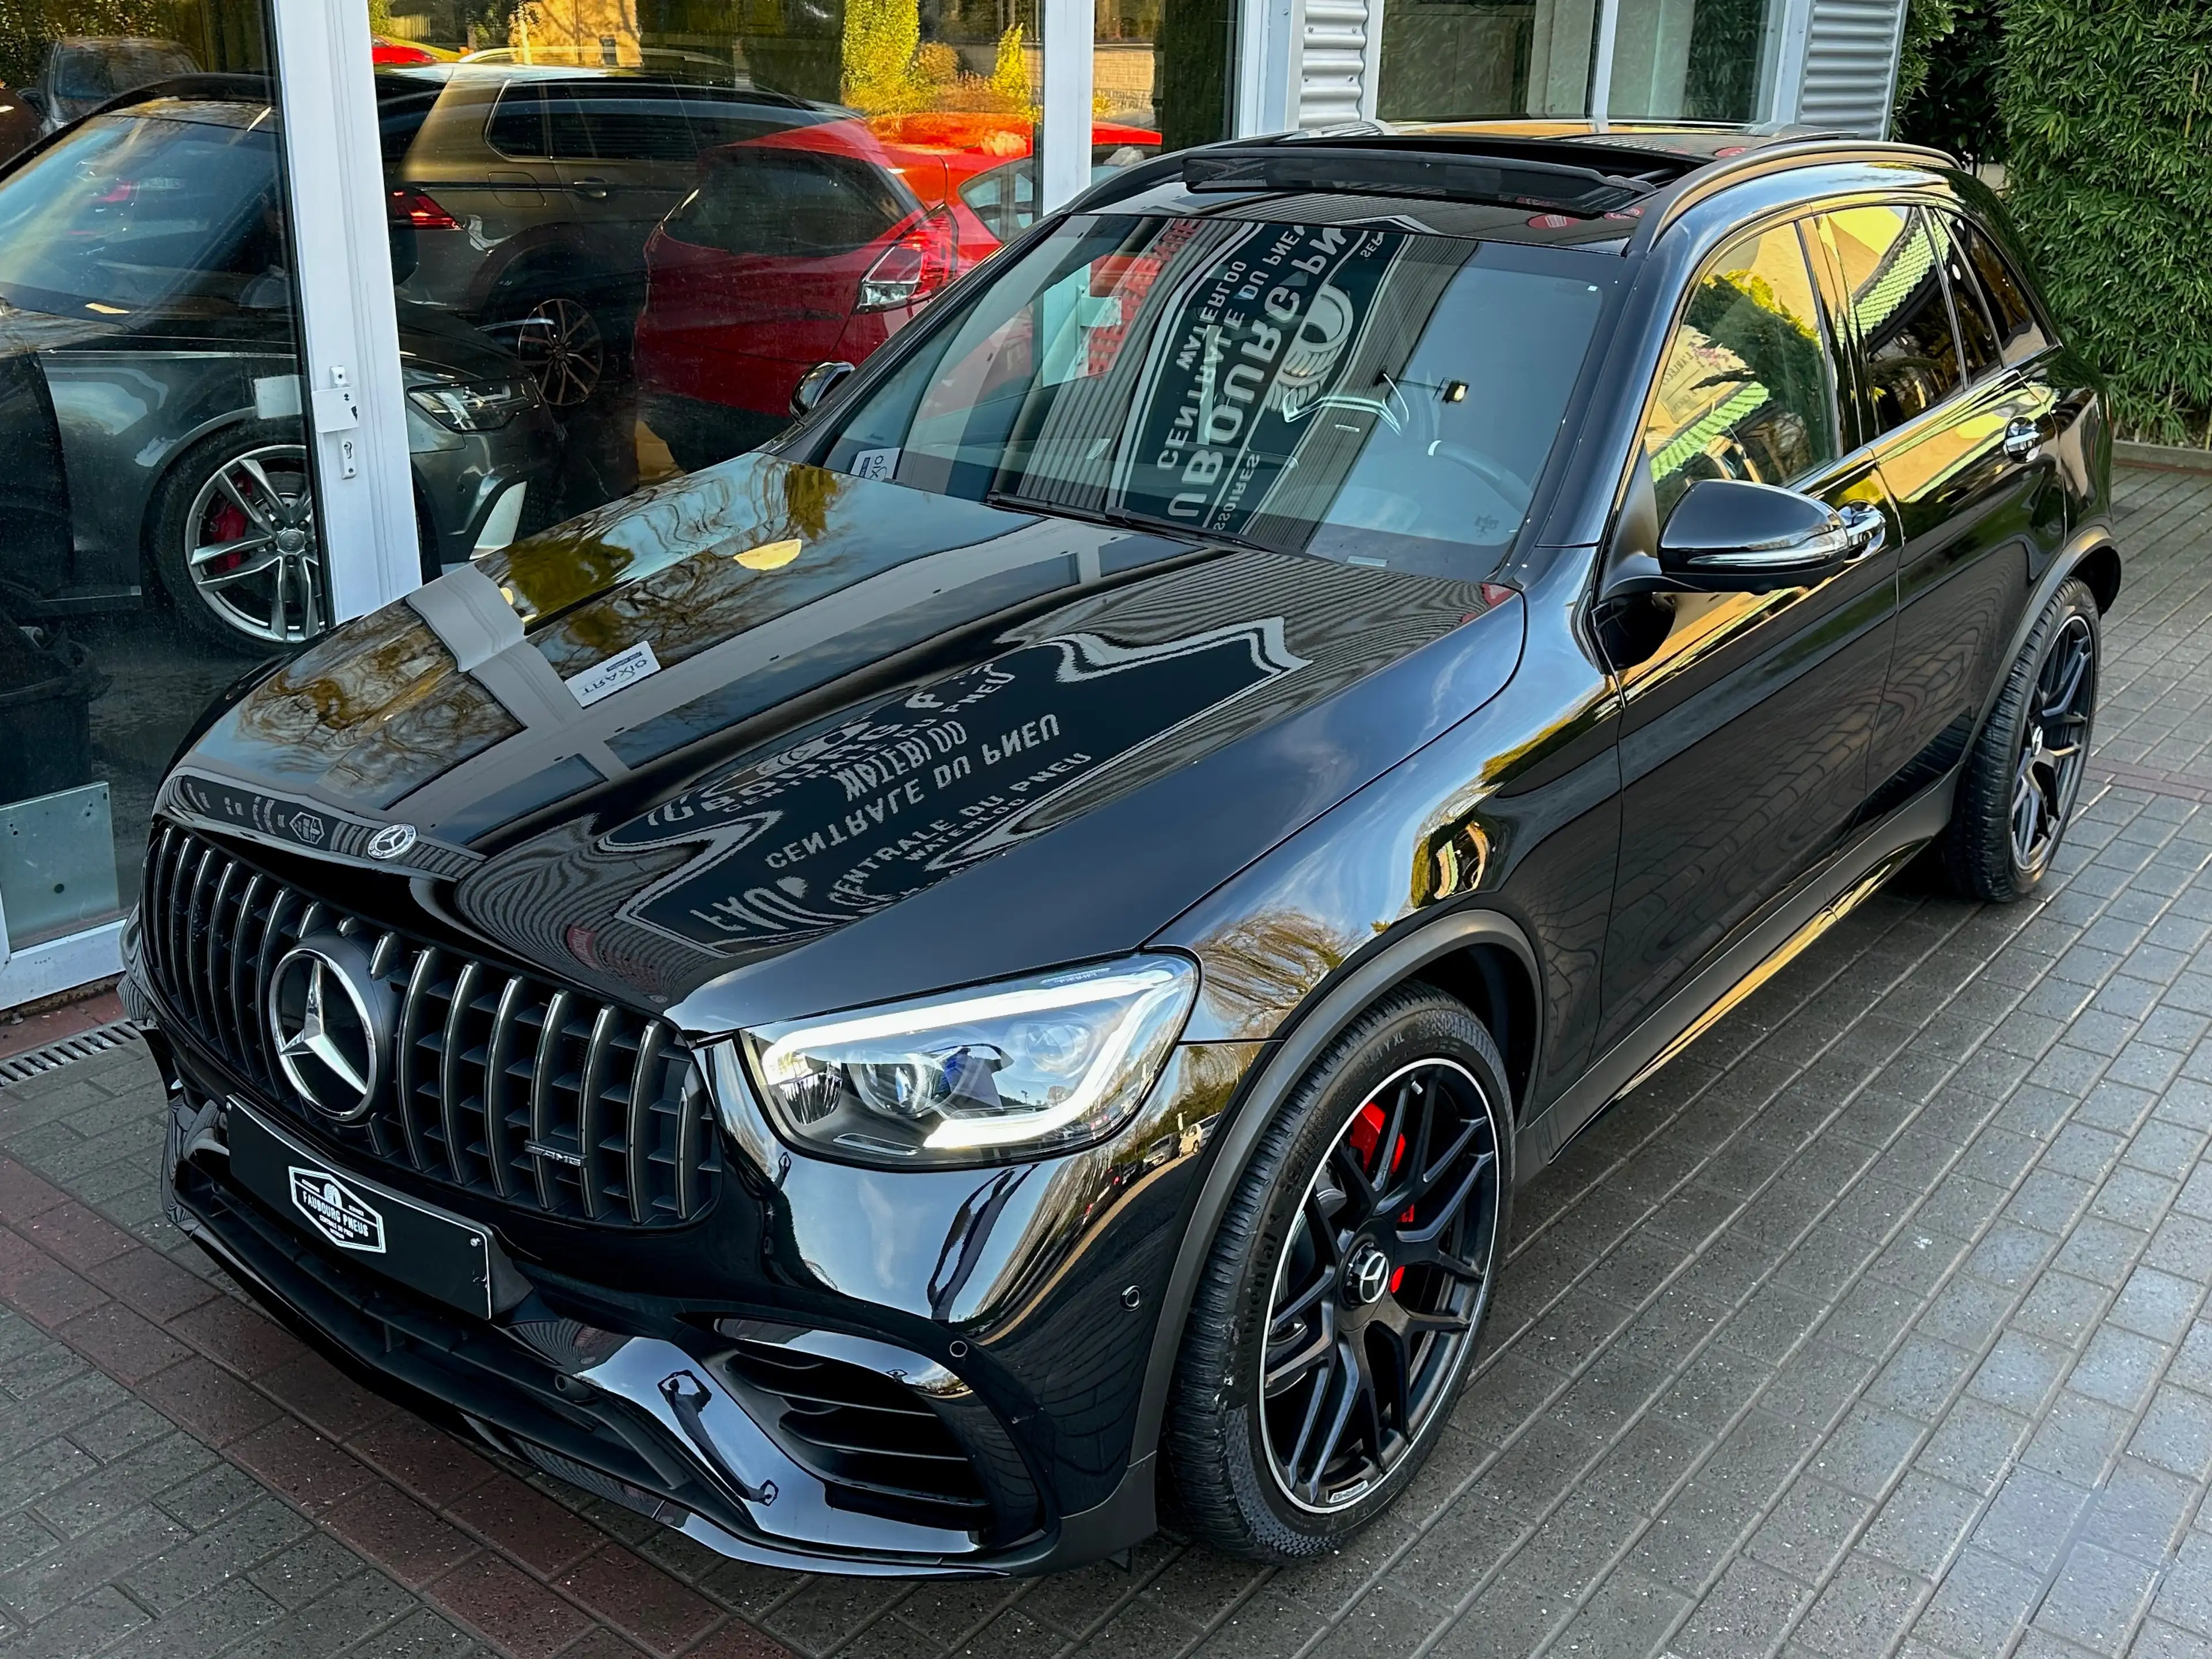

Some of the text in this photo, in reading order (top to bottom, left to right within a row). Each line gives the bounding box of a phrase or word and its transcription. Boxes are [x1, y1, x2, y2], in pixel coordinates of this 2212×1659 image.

[959, 794, 1005, 817] DU
[1009, 752, 1092, 792] PNEU
[302, 1190, 342, 1223] FAUBOURG
[342, 1214, 369, 1237] PNEUS
